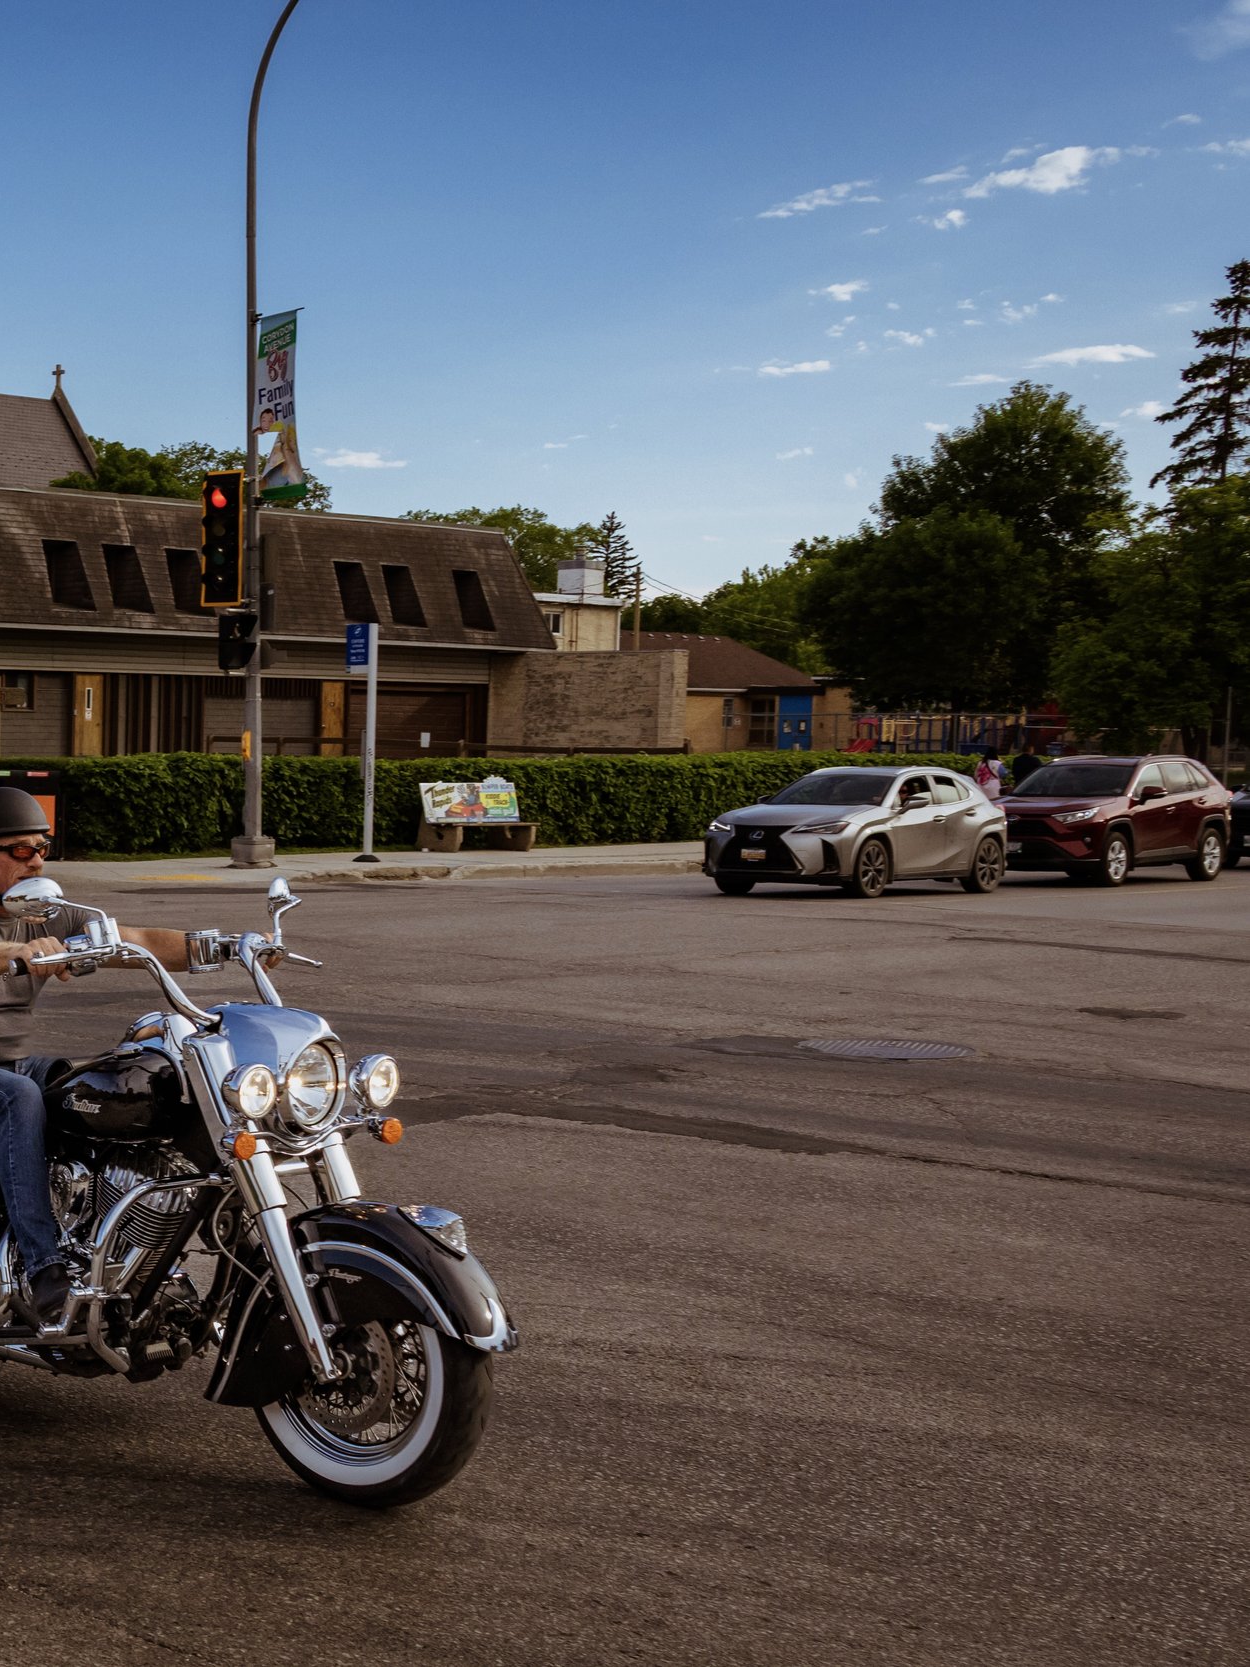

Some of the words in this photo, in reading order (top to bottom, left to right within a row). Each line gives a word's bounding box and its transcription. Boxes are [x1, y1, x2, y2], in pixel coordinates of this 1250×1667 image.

[261, 322, 295, 344] CORYDON
[263, 335, 292, 353] AVENUE
[258, 379, 294, 405] Family
[274, 400, 295, 421] Fun
